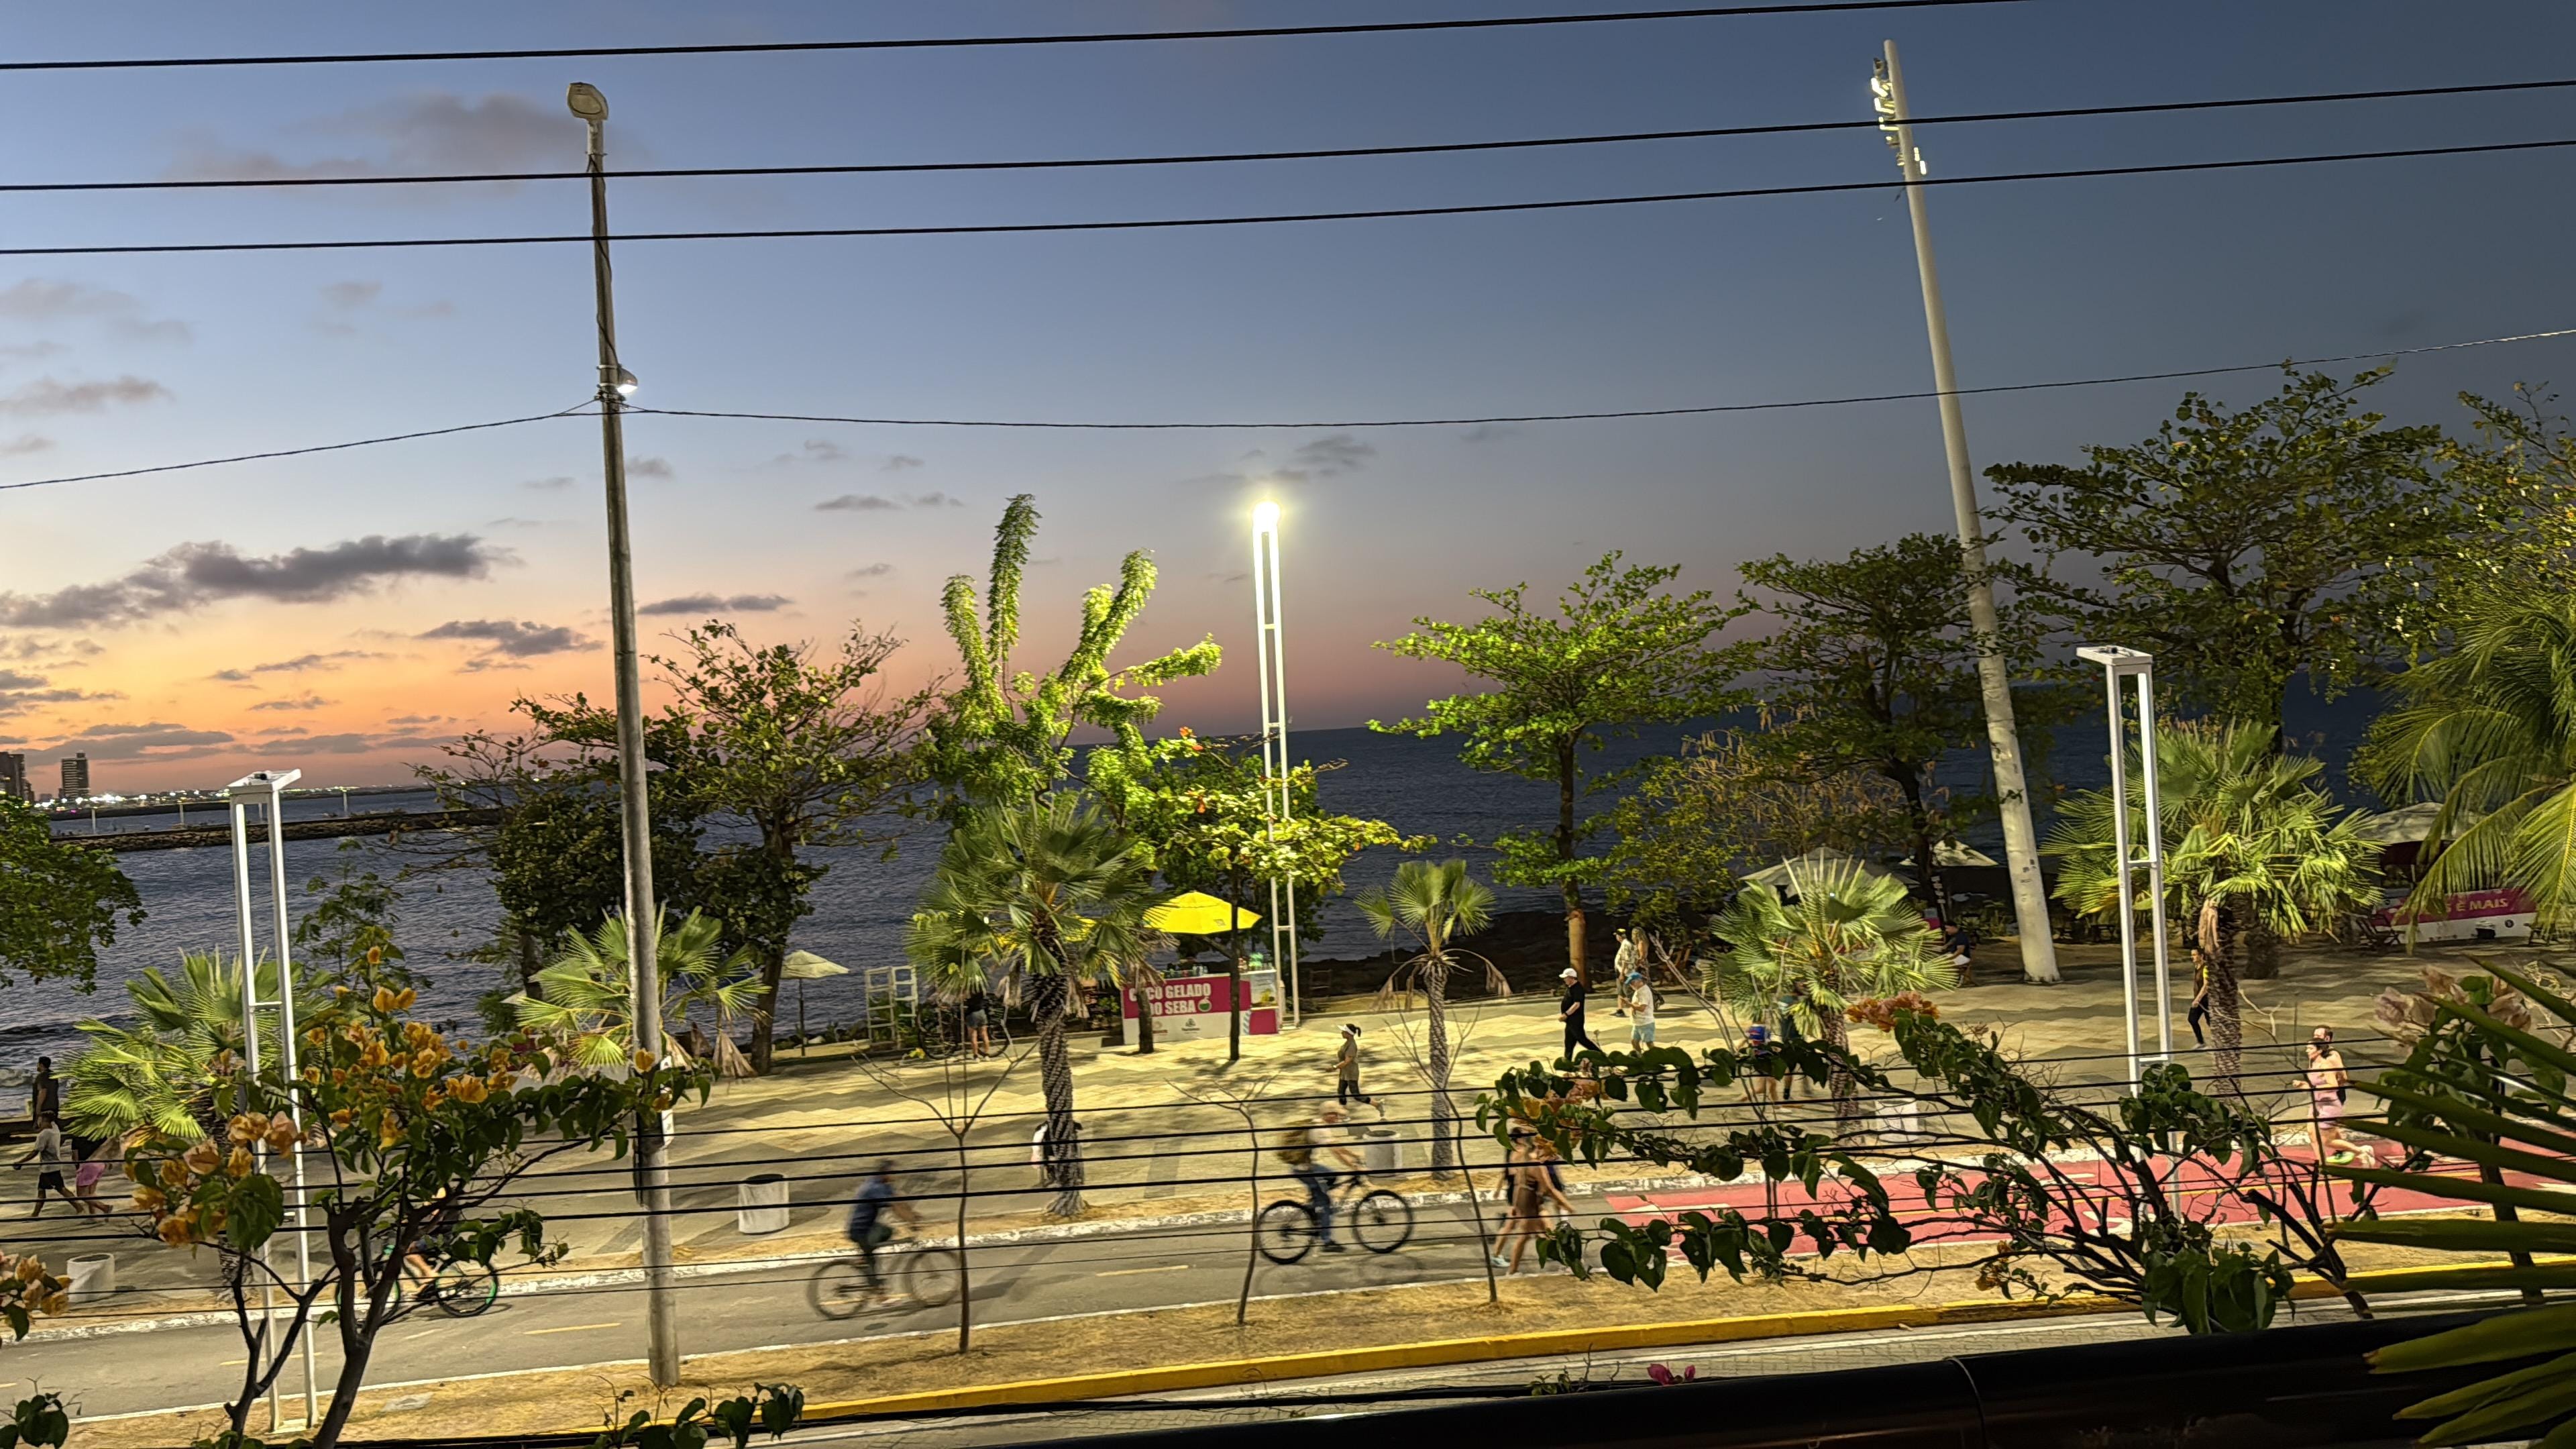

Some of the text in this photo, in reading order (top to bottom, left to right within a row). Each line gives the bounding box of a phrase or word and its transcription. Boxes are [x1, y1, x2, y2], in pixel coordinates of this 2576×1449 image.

[2469, 898, 2508, 910] MAIS
[1129, 983, 1211, 1001] CCO GELADO
[1165, 1000, 1196, 1014] SEBA
